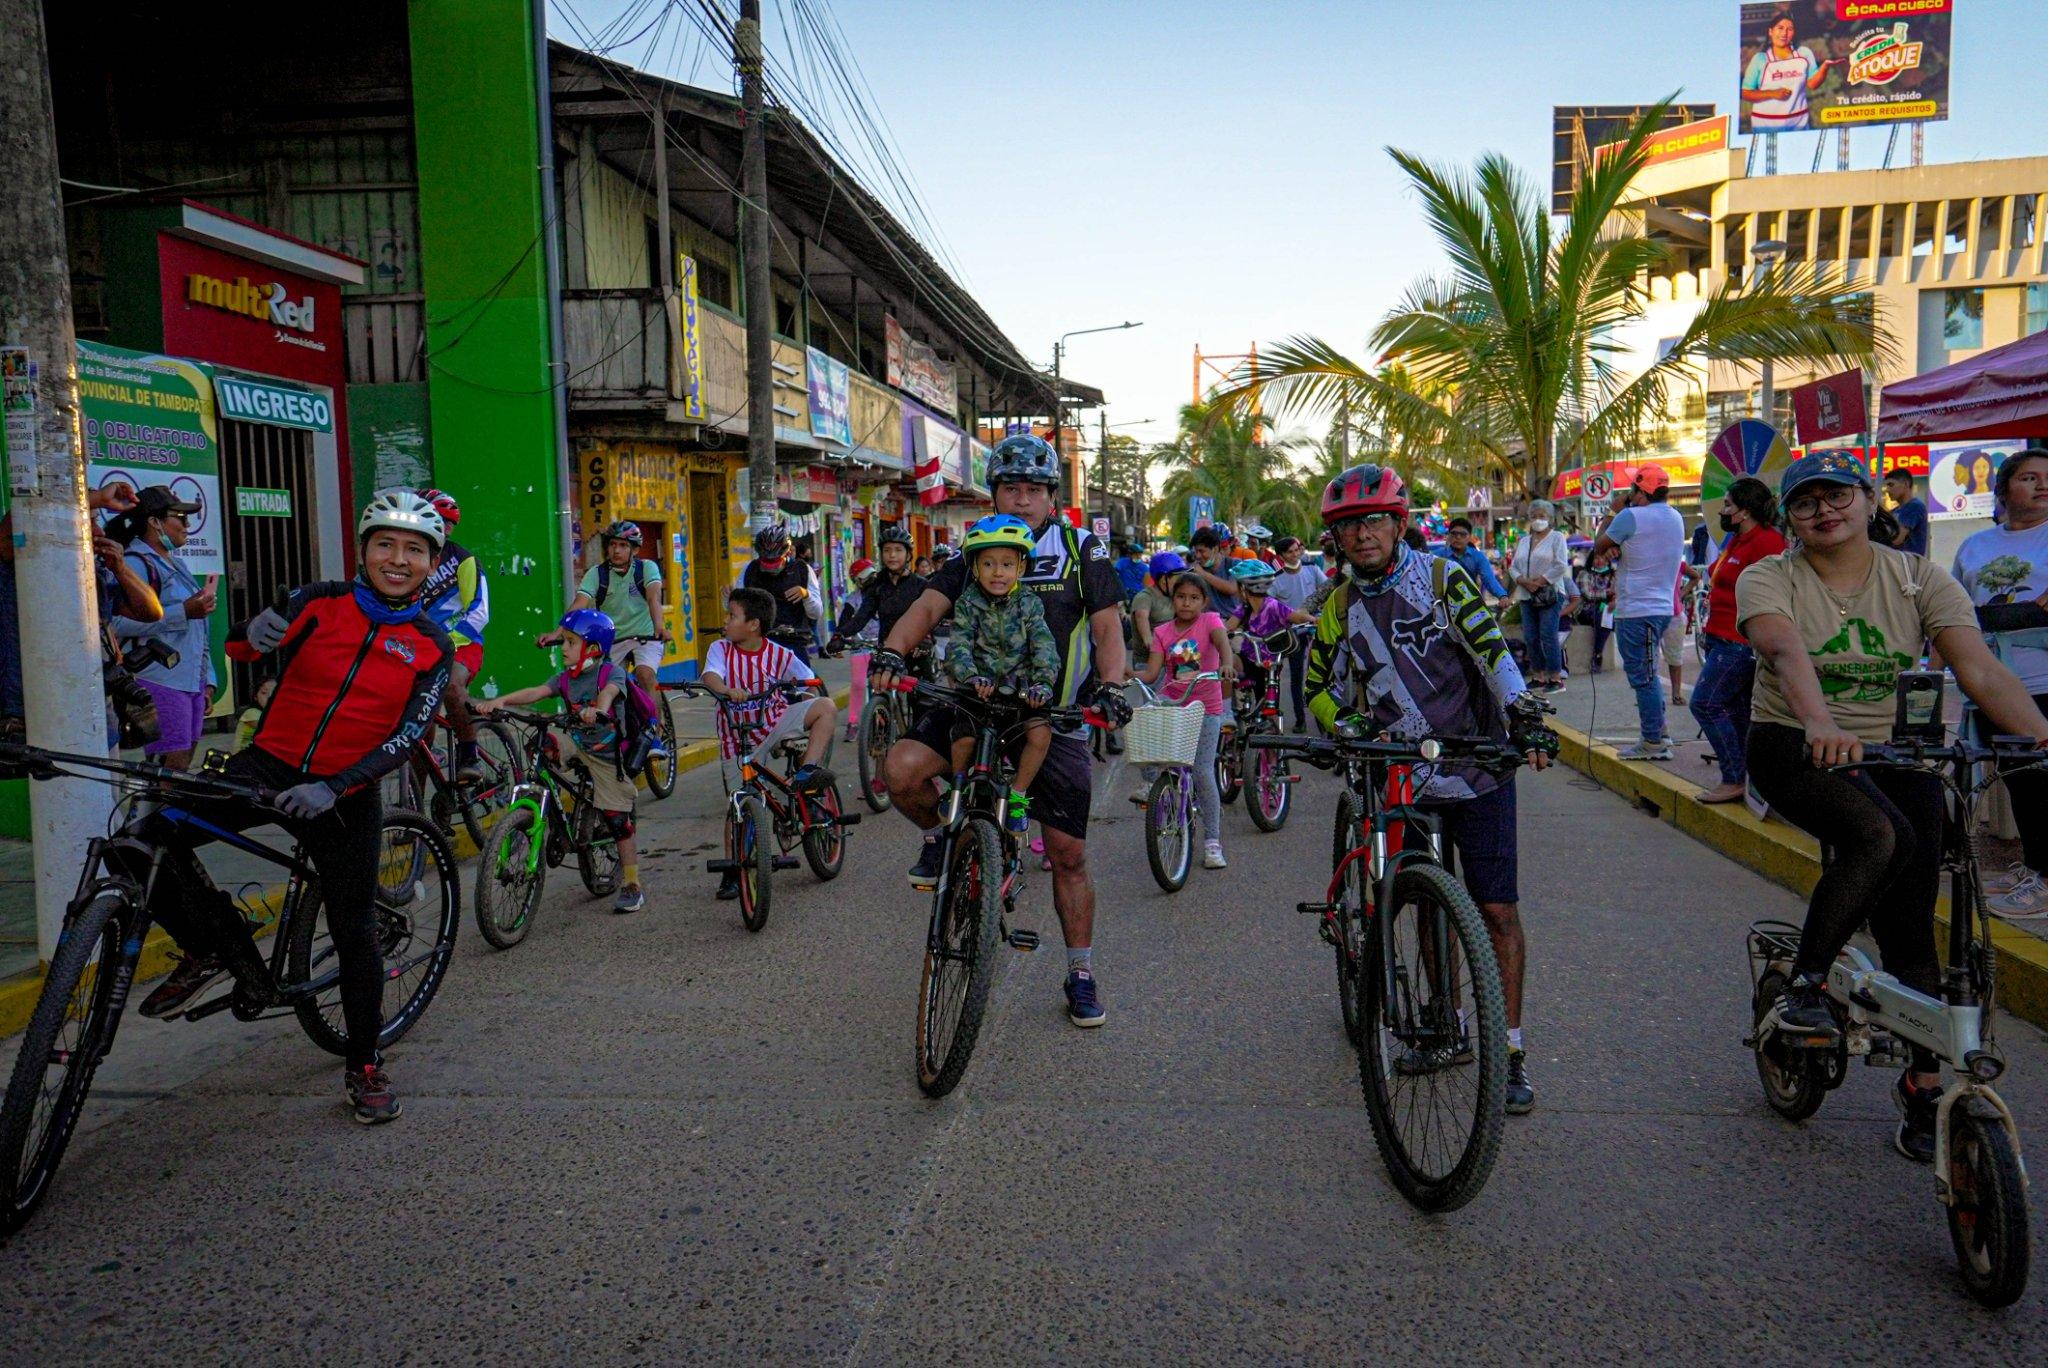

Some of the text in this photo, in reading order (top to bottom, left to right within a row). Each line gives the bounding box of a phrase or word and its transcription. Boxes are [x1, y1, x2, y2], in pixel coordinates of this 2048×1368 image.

[1860, 0, 1944, 14] CAJA CUSCO
[1850, 28, 1875, 48] Solicita
[1861, 45, 1919, 77] TOQUE
[1837, 91, 1922, 105] Tu crédito, rápido
[1826, 104, 1931, 119] SIN TANTOS REQUISITOS
[1665, 128, 1721, 153] CUSCO
[79, 380, 133, 404] OVINCIAL
[136, 389, 151, 407] DE
[223, 384, 329, 426] INGRESO
[104, 420, 207, 449] OBLIGATORIO
[107, 440, 180, 466] INGRESO
[239, 492, 290, 513] ENTRADA
